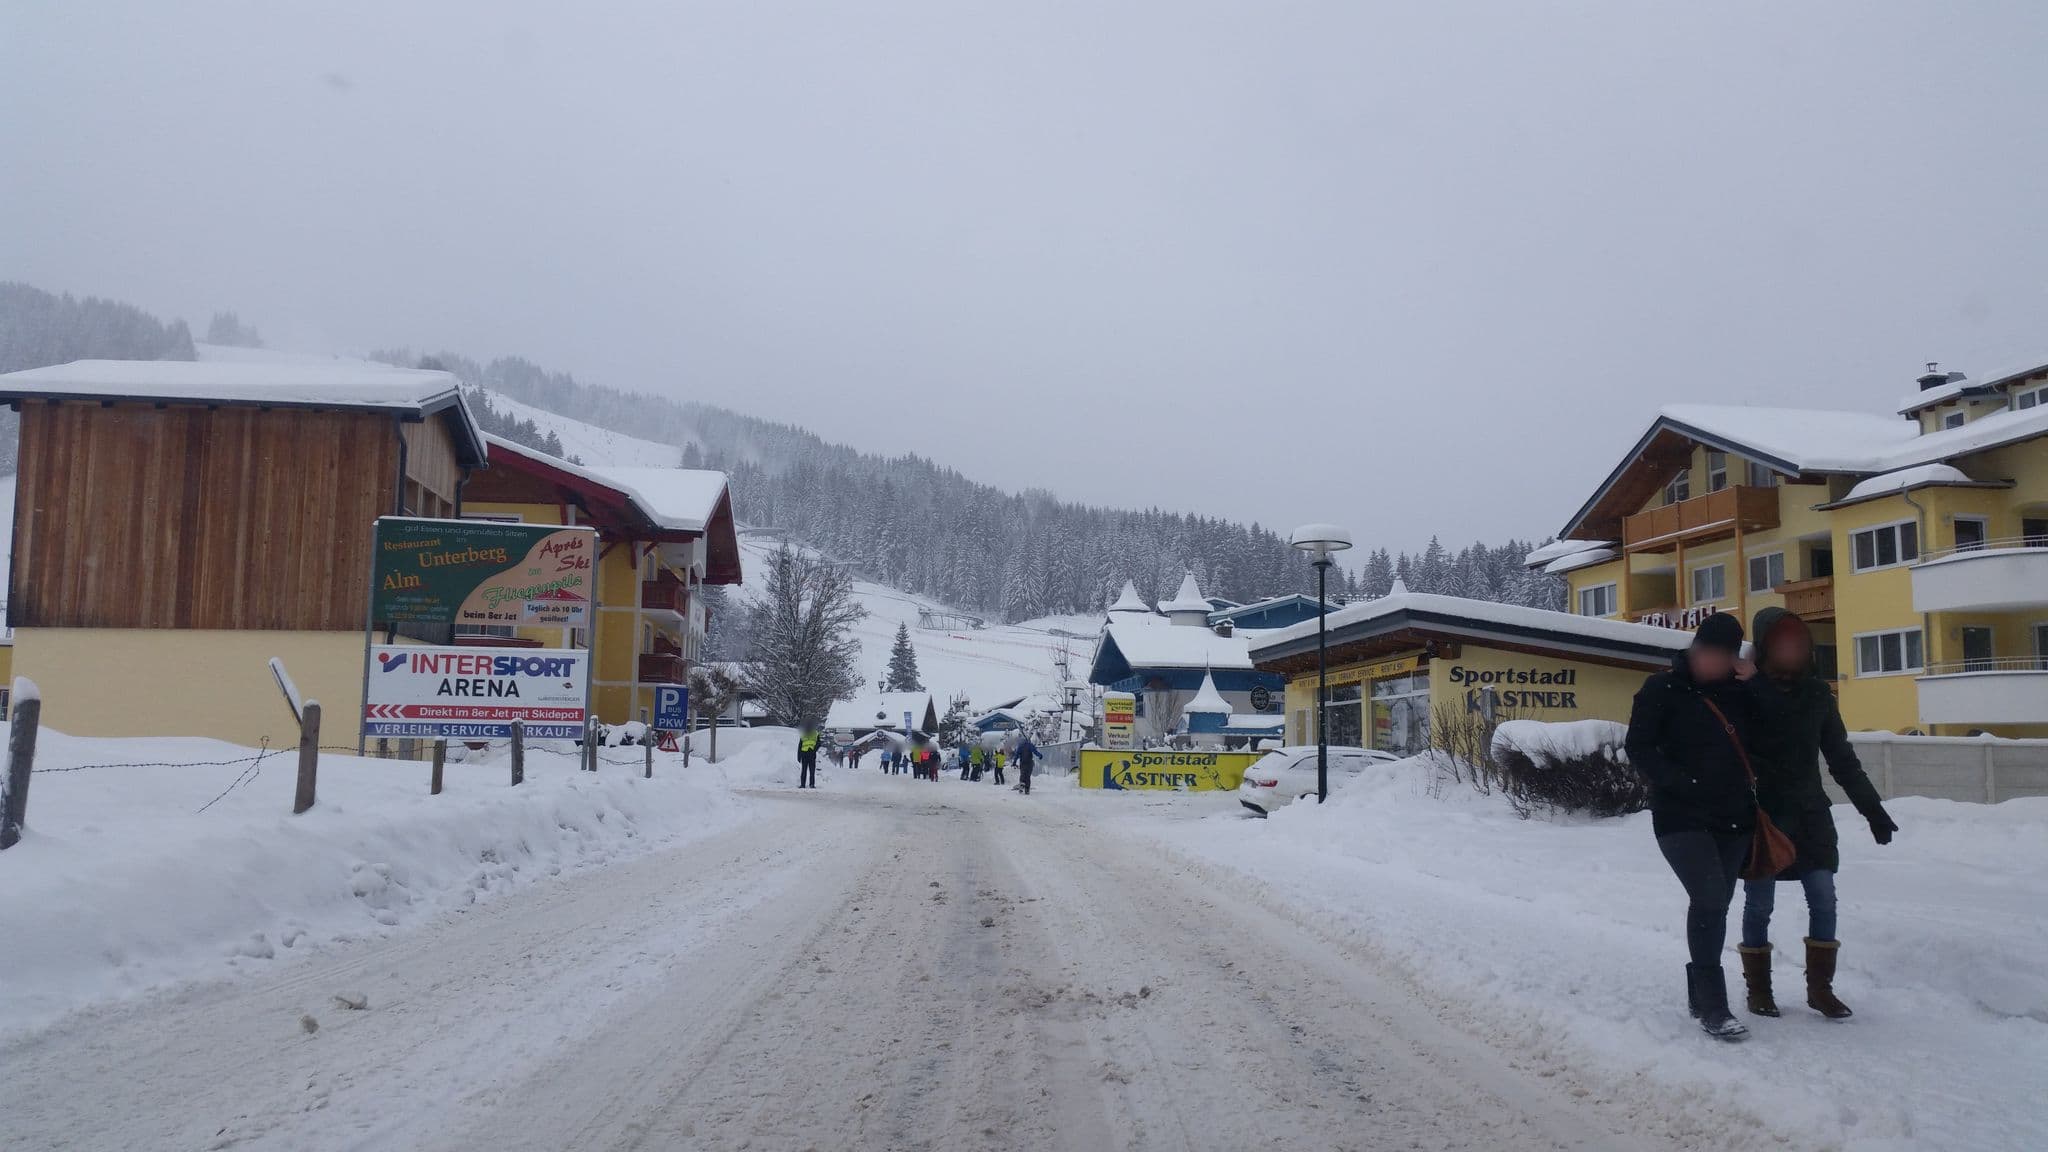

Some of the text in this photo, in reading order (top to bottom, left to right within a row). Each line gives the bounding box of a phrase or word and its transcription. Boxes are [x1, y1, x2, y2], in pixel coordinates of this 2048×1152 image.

[384, 538, 441, 552] Restaurant
[418, 544, 508, 569] Unterberg
[555, 555, 590, 572] Ski
[384, 571, 421, 591] Alm
[482, 574, 583, 609] Fliegenpilz
[463, 611, 517, 621] beim 8er Jet
[527, 604, 583, 615] Täglich ab 10 Uhr
[412, 652, 576, 678] INTERSPORT
[1449, 666, 1577, 687] Sportstadl
[436, 678, 520, 698] ARENA
[660, 688, 680, 714] P
[419, 706, 579, 721] Direkt im 8er Jet mit Skidepot
[658, 717, 684, 728] PKW
[375, 723, 573, 737] VERLEIH- SERVICE- RKAUF
[1132, 753, 1217, 767] Sportstadl
[1103, 760, 1197, 790] KASTNER
